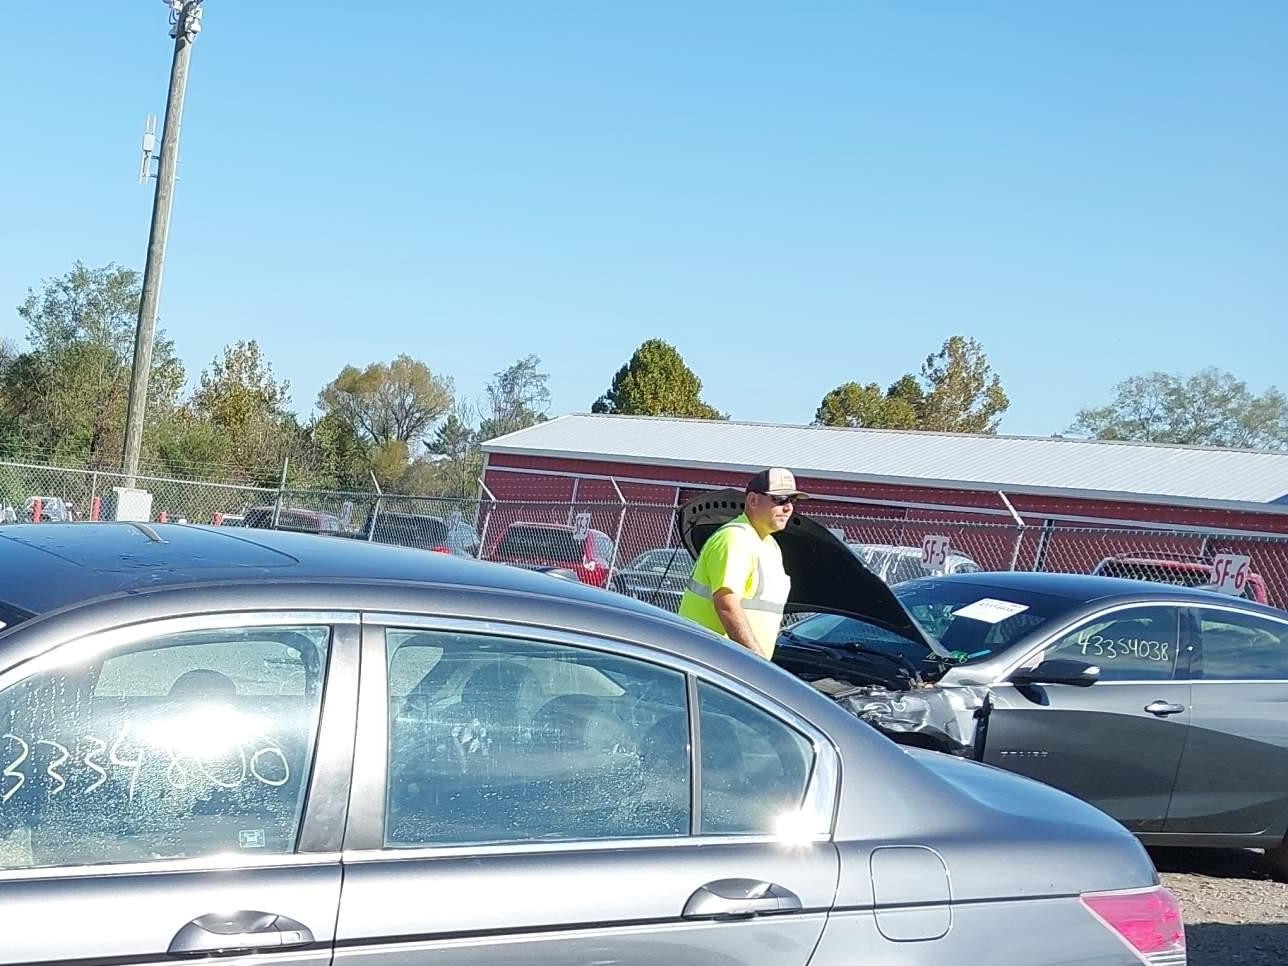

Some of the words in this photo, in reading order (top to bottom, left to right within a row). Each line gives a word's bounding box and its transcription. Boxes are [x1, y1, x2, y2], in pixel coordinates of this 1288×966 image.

[922, 539, 948, 565] SF-5
[1211, 558, 1247, 589] SF-6
[1077, 631, 1169, 661] 43354038
